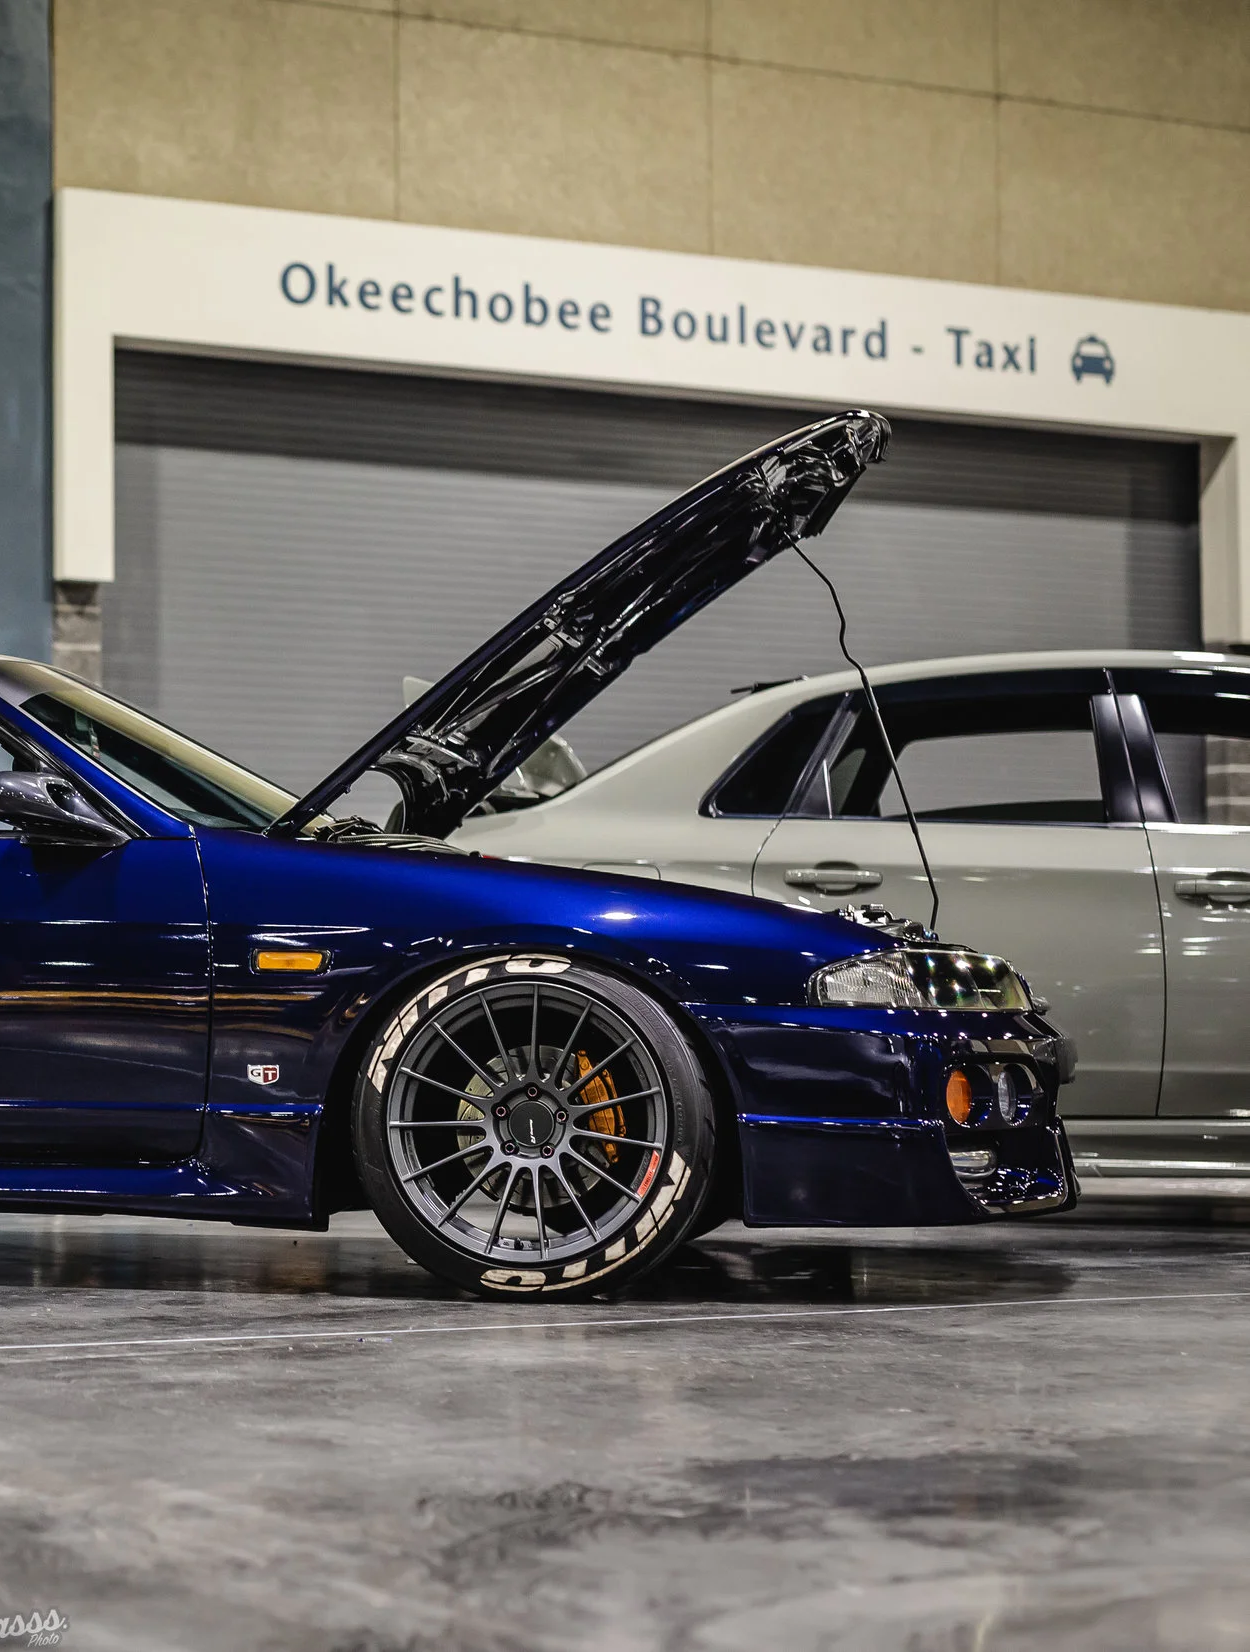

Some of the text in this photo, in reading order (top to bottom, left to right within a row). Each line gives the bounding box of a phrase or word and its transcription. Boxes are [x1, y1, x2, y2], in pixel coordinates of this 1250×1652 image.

[279, 261, 613, 334] Okeechobee
[638, 296, 888, 360] Boulevard
[945, 325, 1038, 374] Taxi
[250, 1068, 277, 1081] GT
[367, 953, 572, 1094] NITTO
